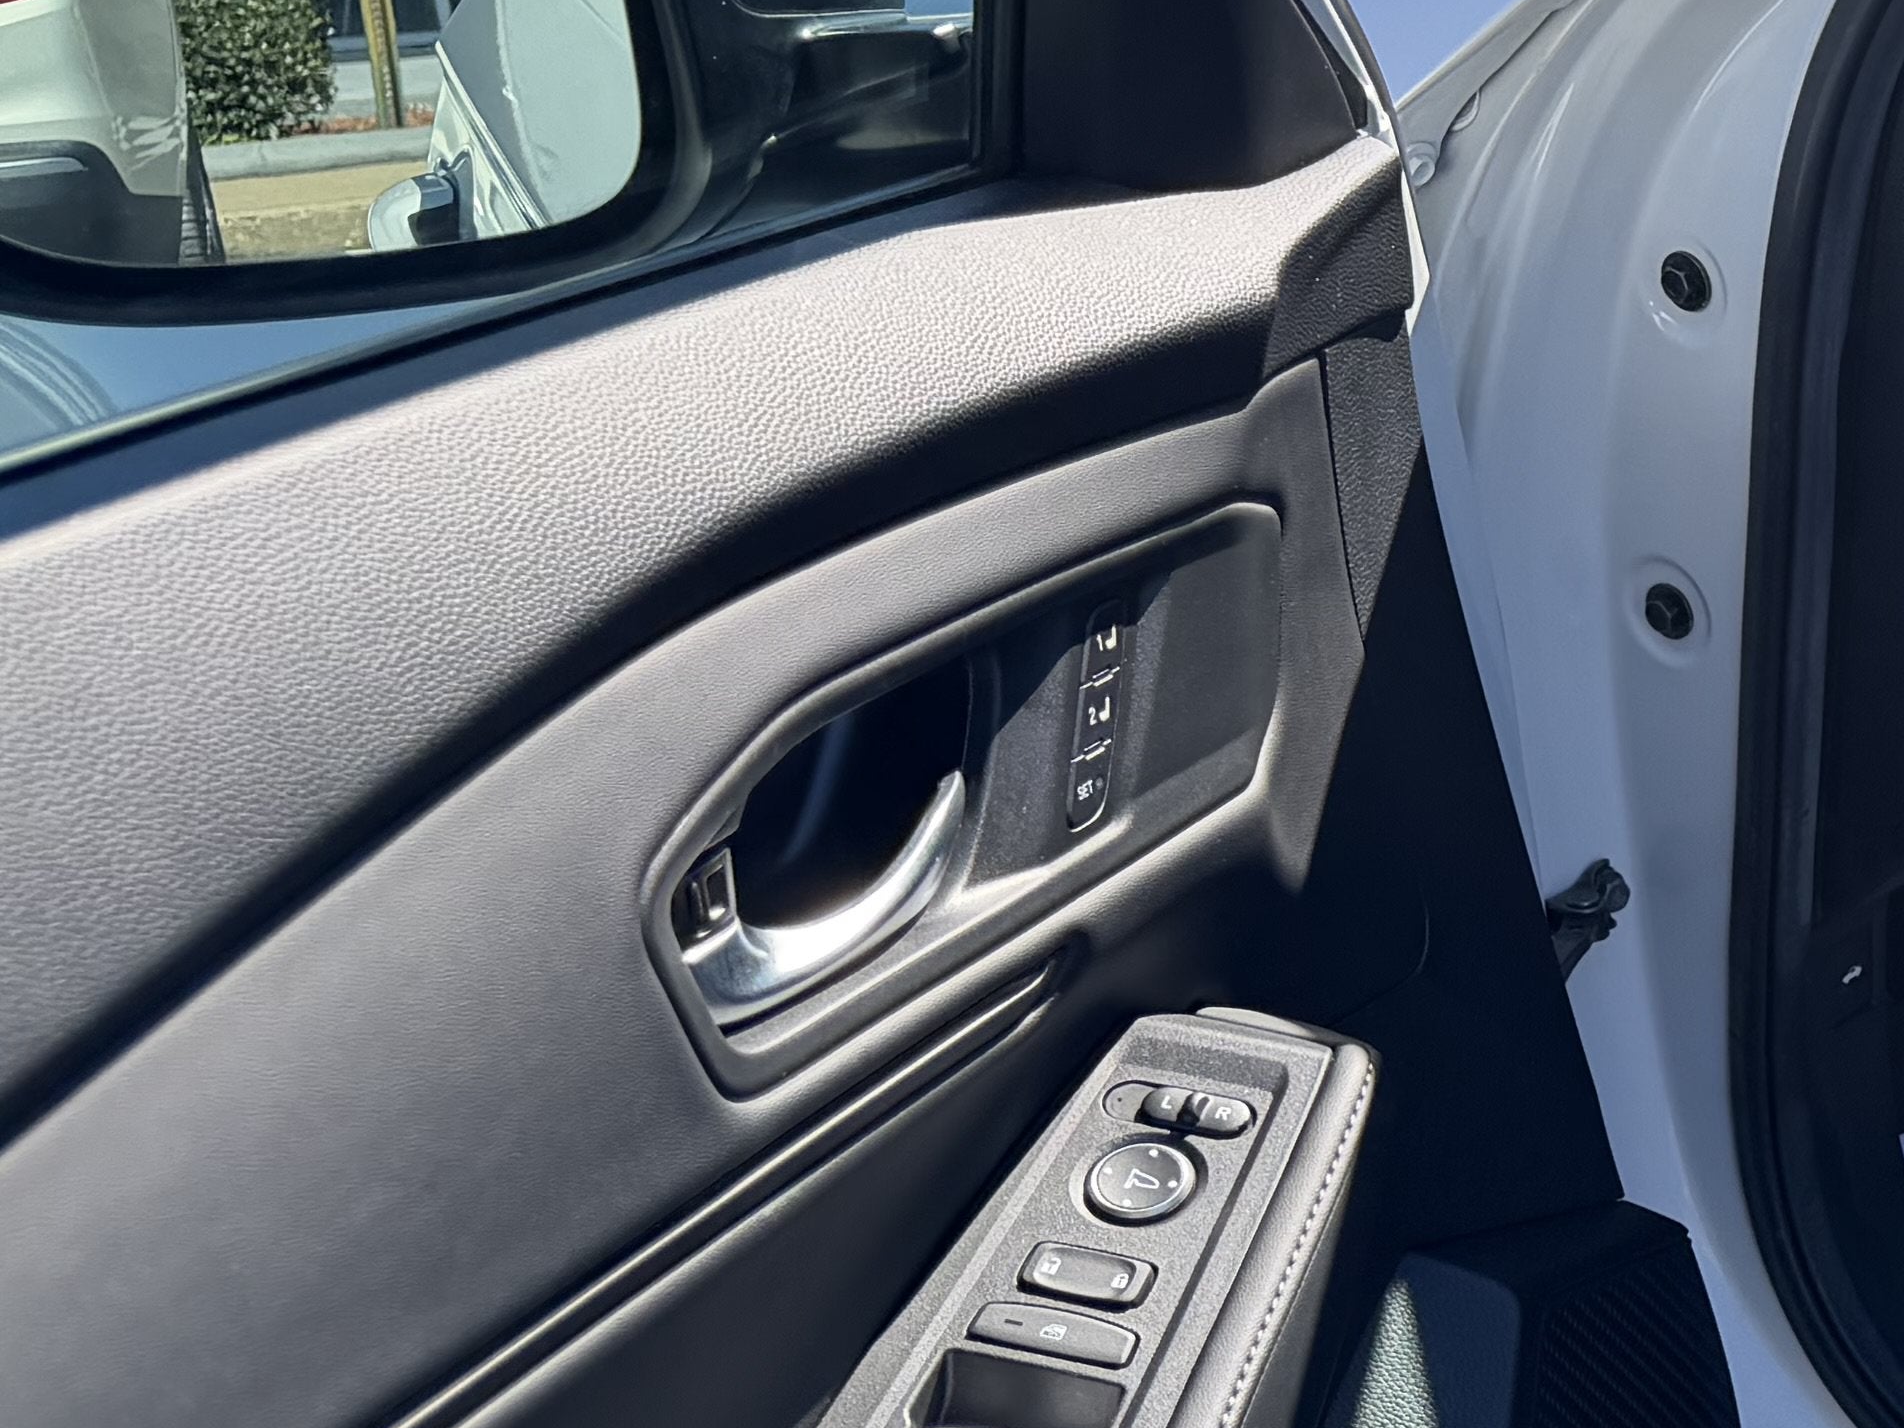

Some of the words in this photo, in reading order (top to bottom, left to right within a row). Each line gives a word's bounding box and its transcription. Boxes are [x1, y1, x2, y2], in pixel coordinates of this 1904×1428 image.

[1096, 634, 1103, 652] 1
[1089, 707, 1097, 725] 2
[1076, 779, 1094, 801] SET
[1162, 1096, 1172, 1110] L
[1216, 1105, 1231, 1121] R
